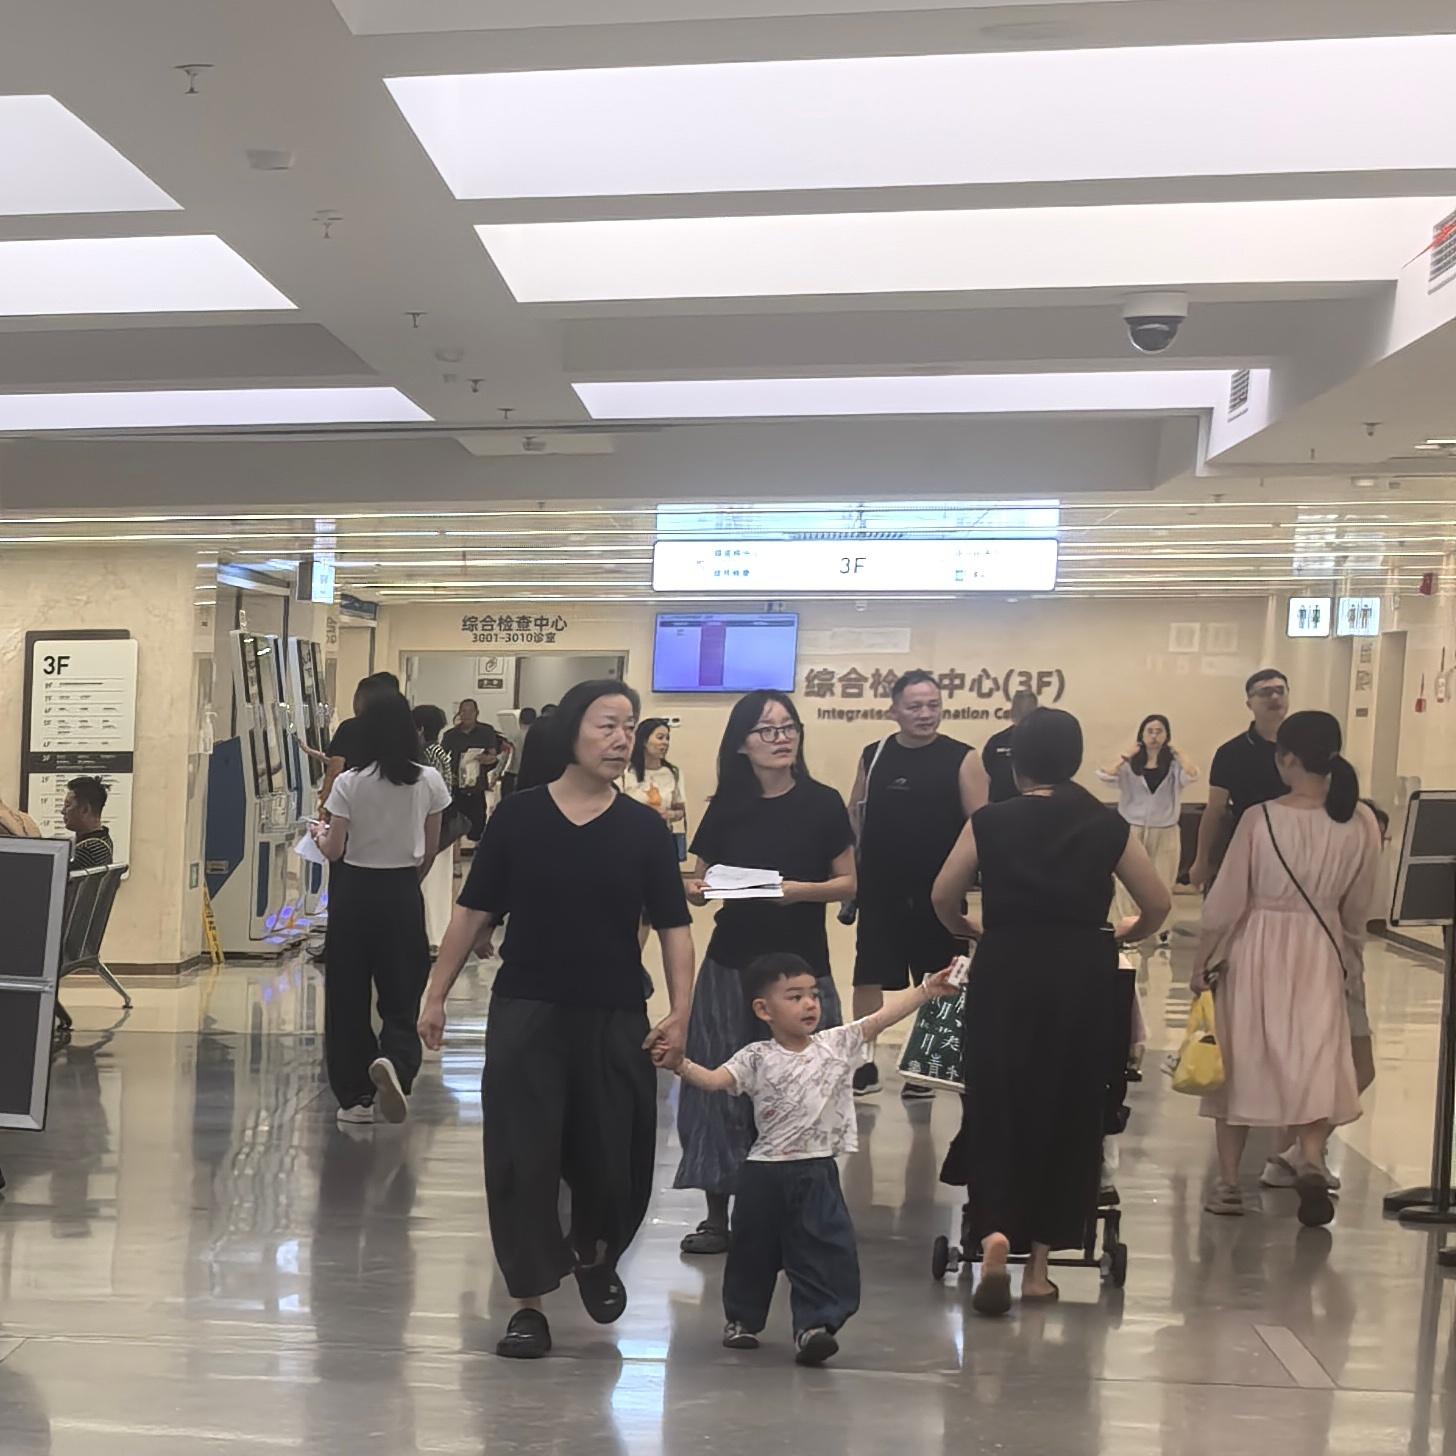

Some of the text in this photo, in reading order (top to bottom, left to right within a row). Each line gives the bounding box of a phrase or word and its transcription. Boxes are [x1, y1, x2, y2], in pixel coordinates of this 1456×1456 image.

[839, 557, 867, 574] 3F
[461, 615, 568, 632] 综合检查中心
[43, 655, 71, 675] 3F
[803, 667, 1066, 703] 综合检中心(3F)
